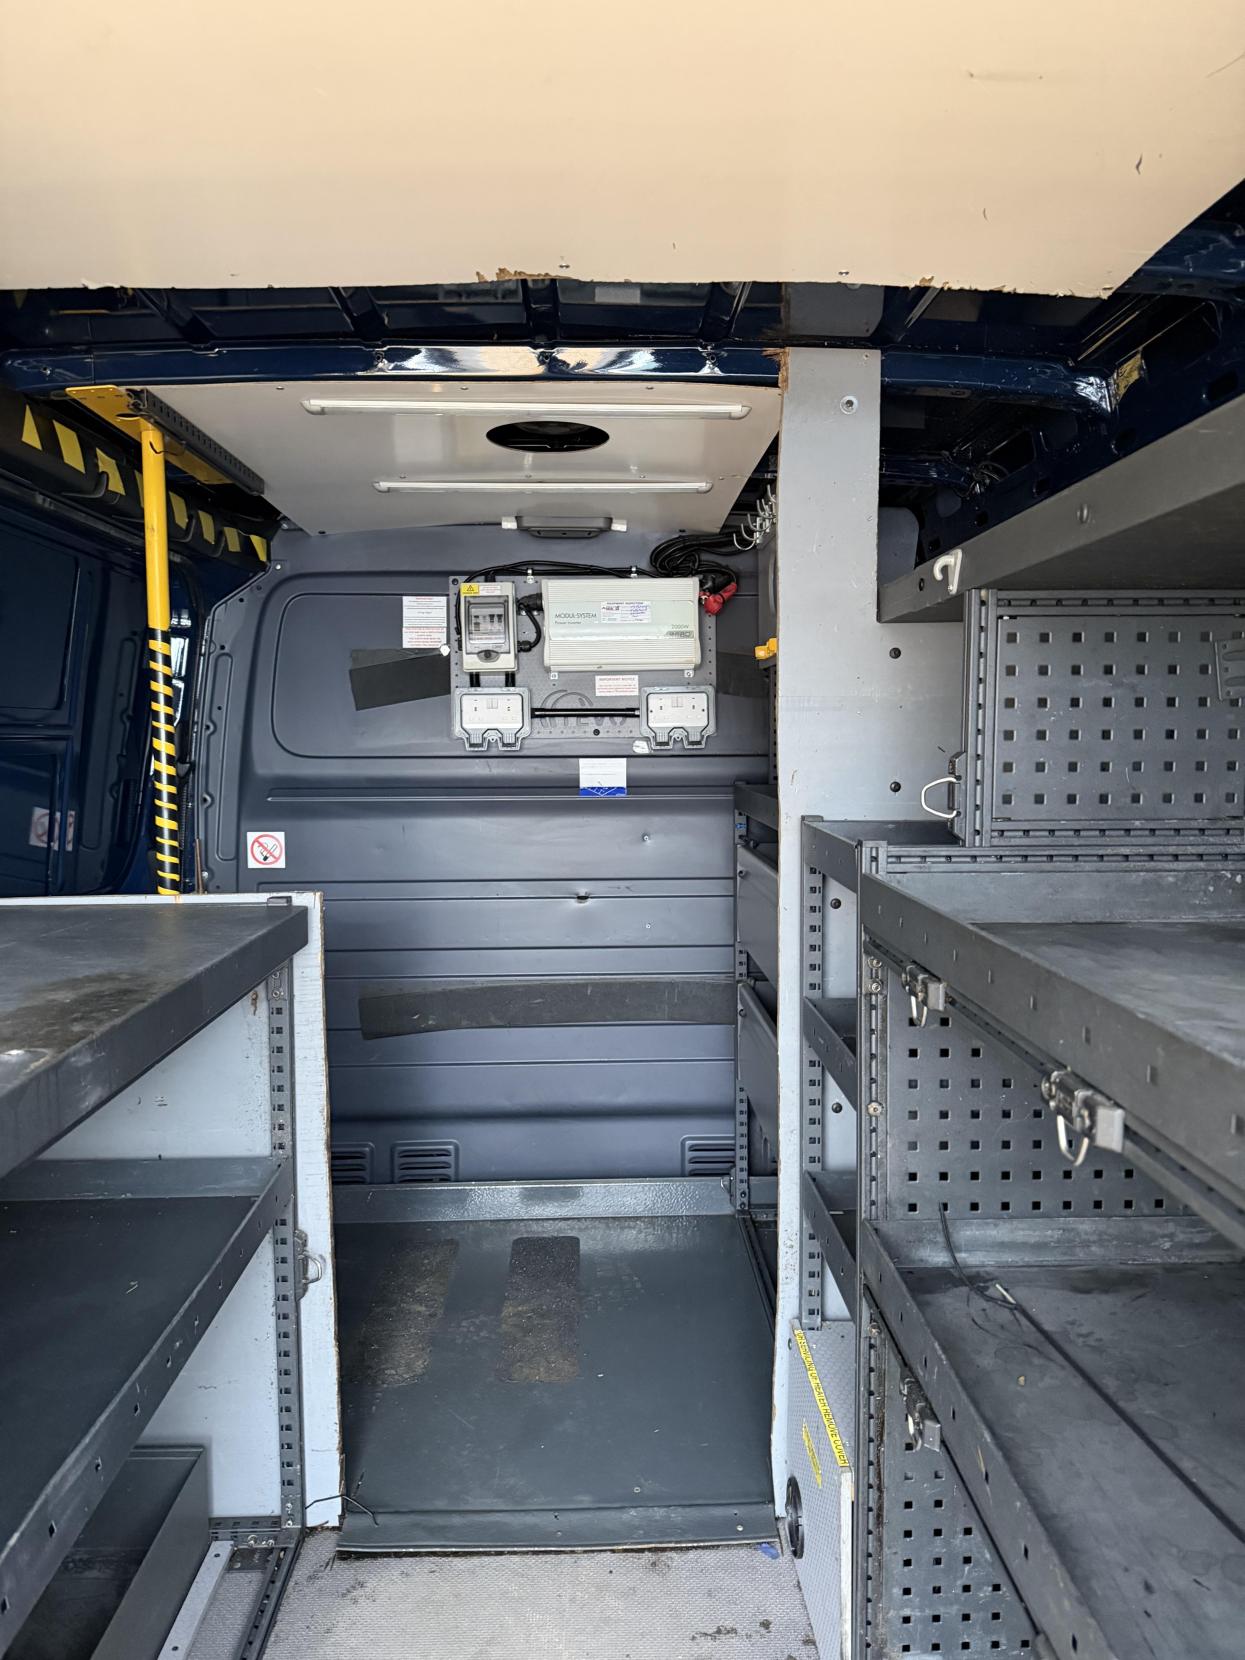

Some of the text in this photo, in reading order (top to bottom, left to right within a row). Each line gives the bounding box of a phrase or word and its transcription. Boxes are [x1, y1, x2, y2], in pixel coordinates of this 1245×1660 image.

[813, 1381, 829, 1408] HEATER
[823, 1408, 839, 1439] REMOVE
[833, 1439, 848, 1465] COVER
